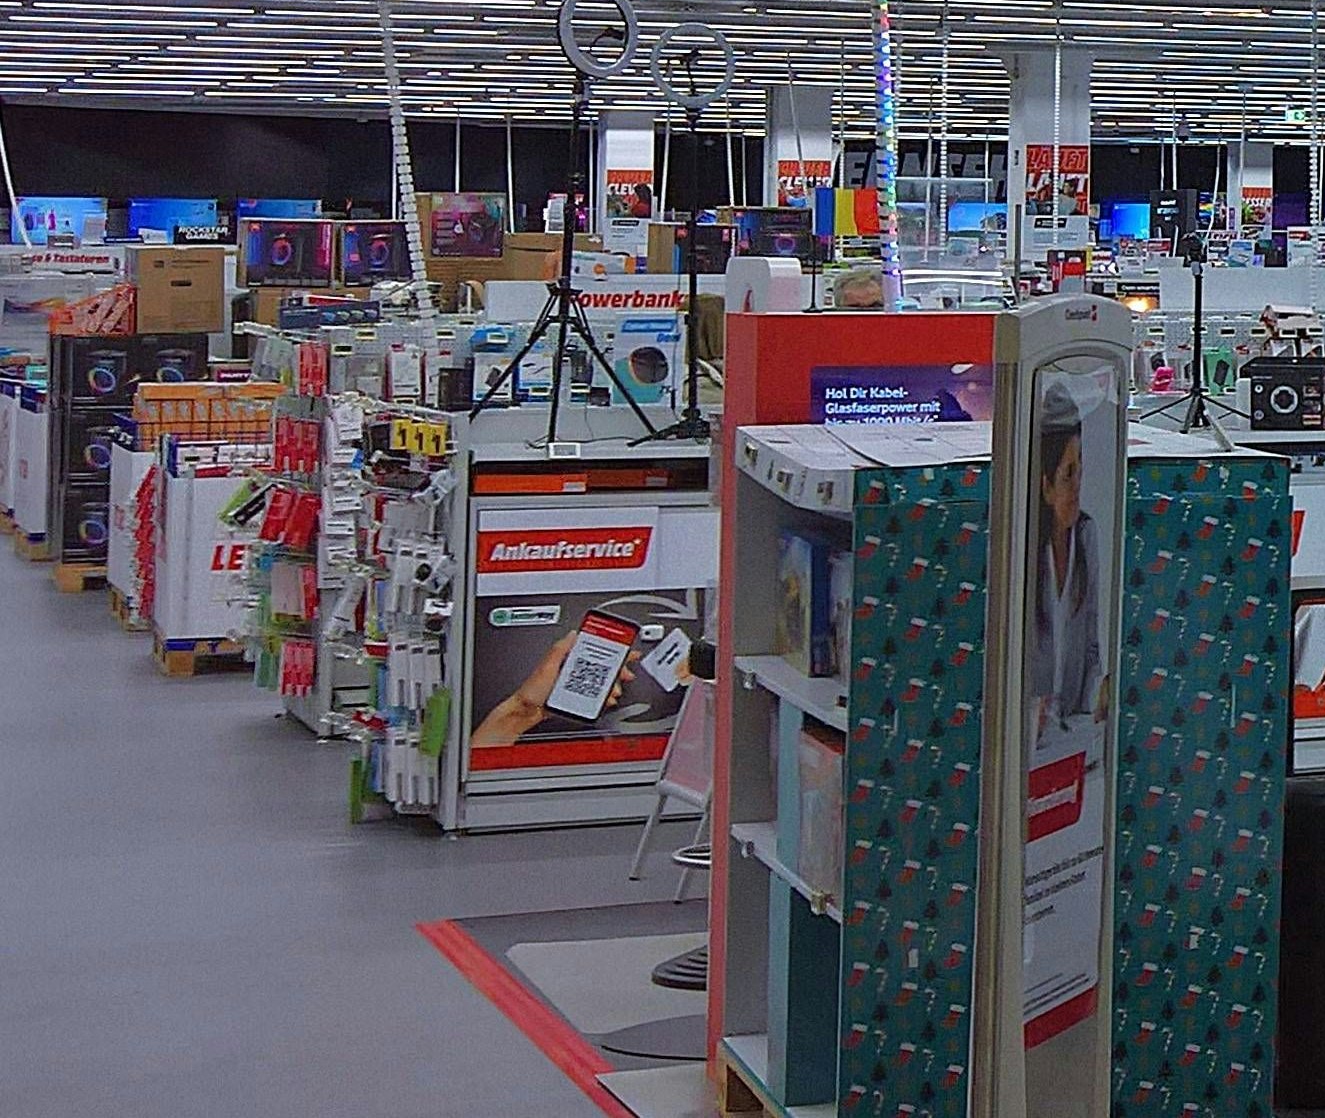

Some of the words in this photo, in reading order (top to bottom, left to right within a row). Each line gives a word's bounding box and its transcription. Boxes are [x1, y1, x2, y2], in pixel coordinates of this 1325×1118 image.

[825, 387, 848, 399] Hol
[849, 387, 868, 399] Dir
[870, 386, 909, 399] Kabel-
[825, 401, 918, 416] Glasfaserpower
[919, 400, 941, 413] mit
